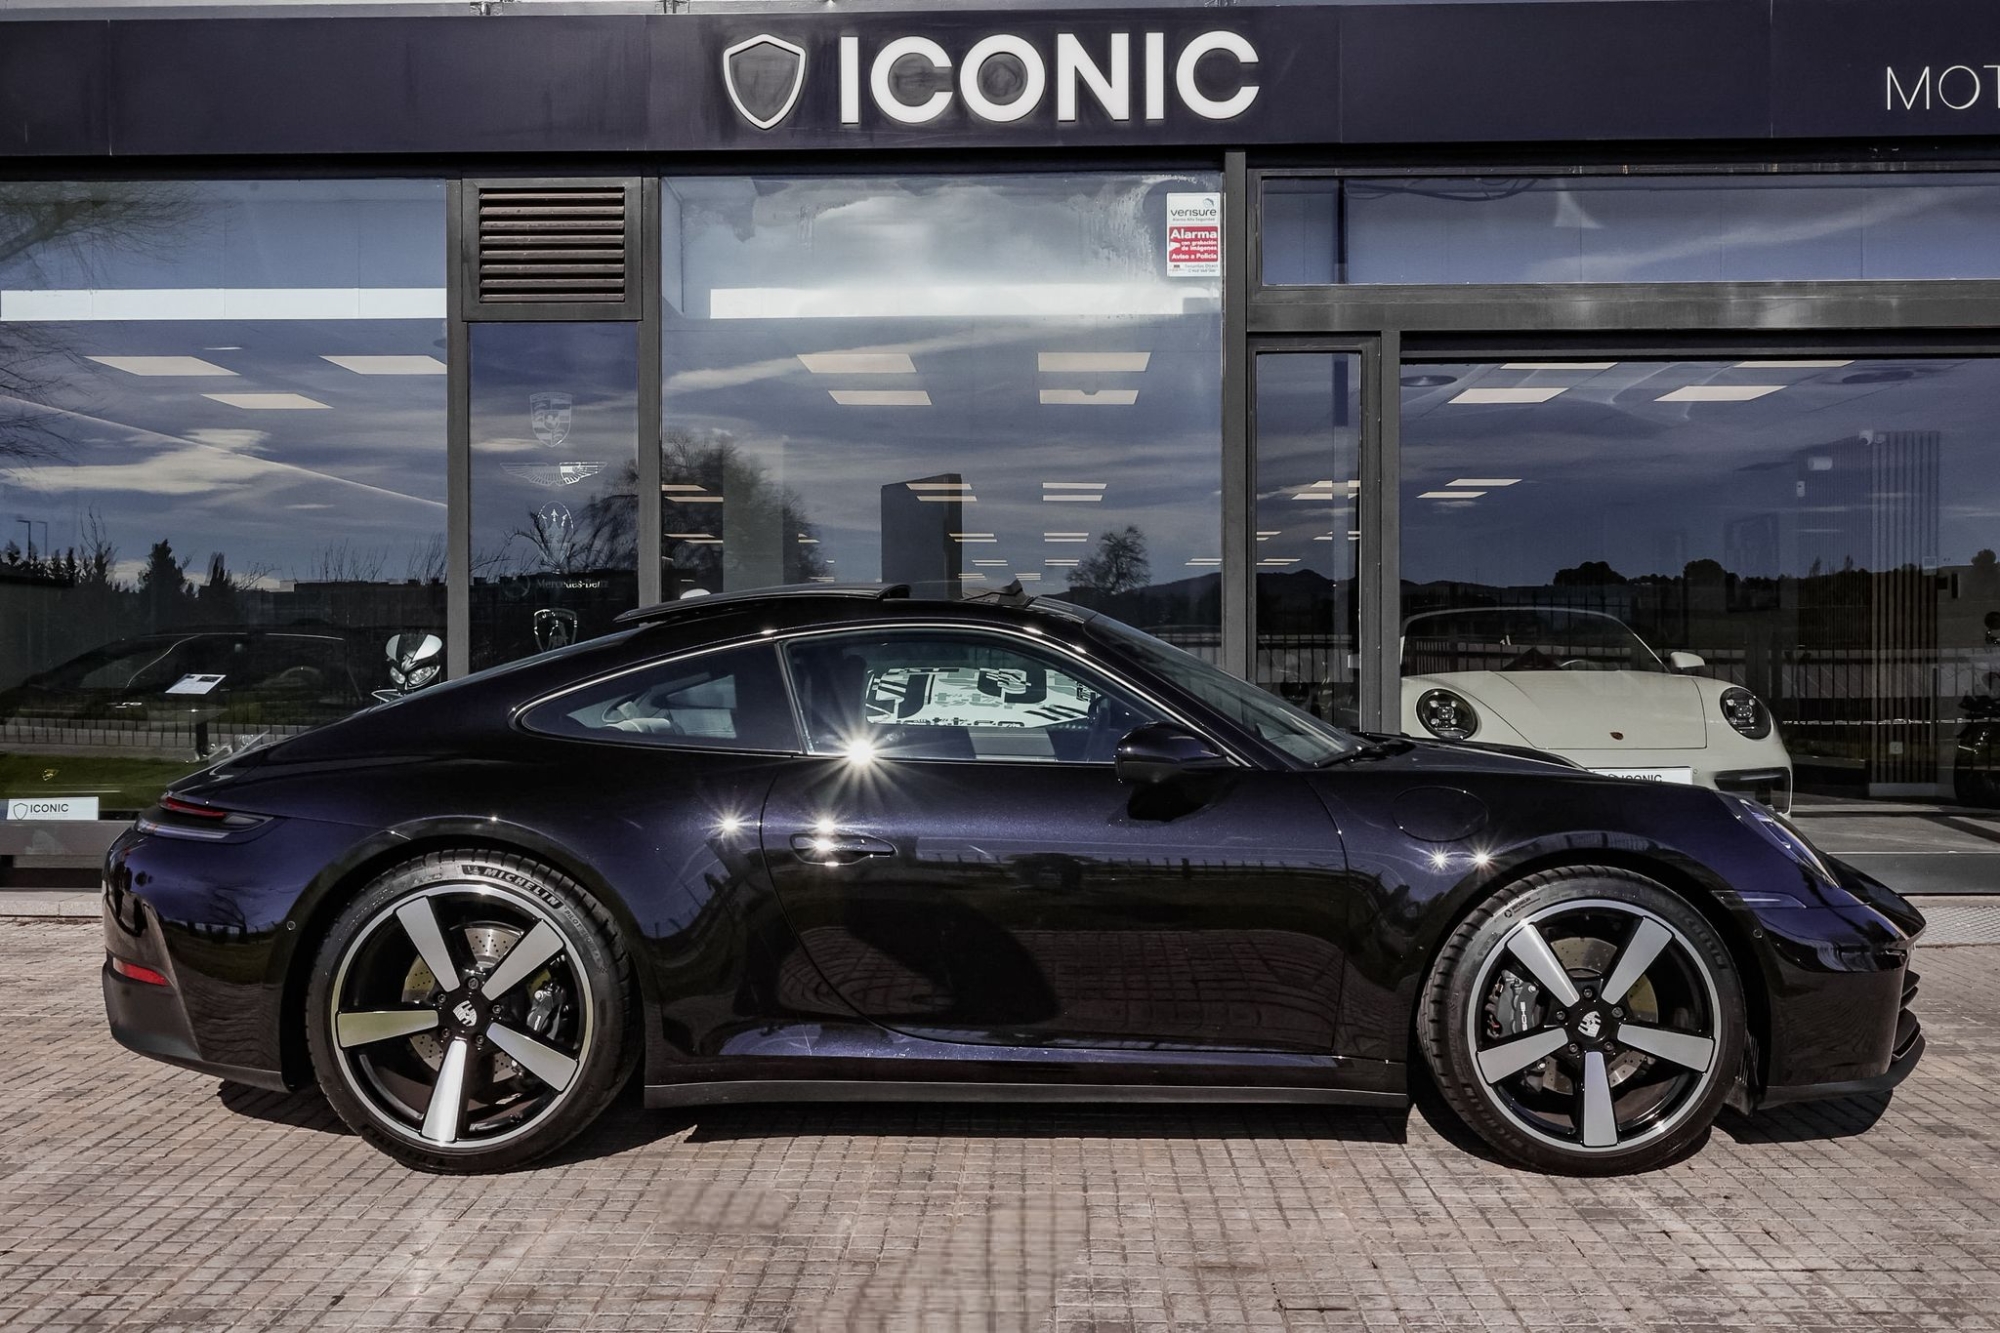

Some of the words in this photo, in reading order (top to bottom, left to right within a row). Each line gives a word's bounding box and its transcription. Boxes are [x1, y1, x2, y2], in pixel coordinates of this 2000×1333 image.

[840, 31, 1260, 124] ICONIC
[1171, 229, 1217, 239] Alarma
[30, 803, 69, 813] ICONIC
[484, 867, 561, 908] MICHELIN
